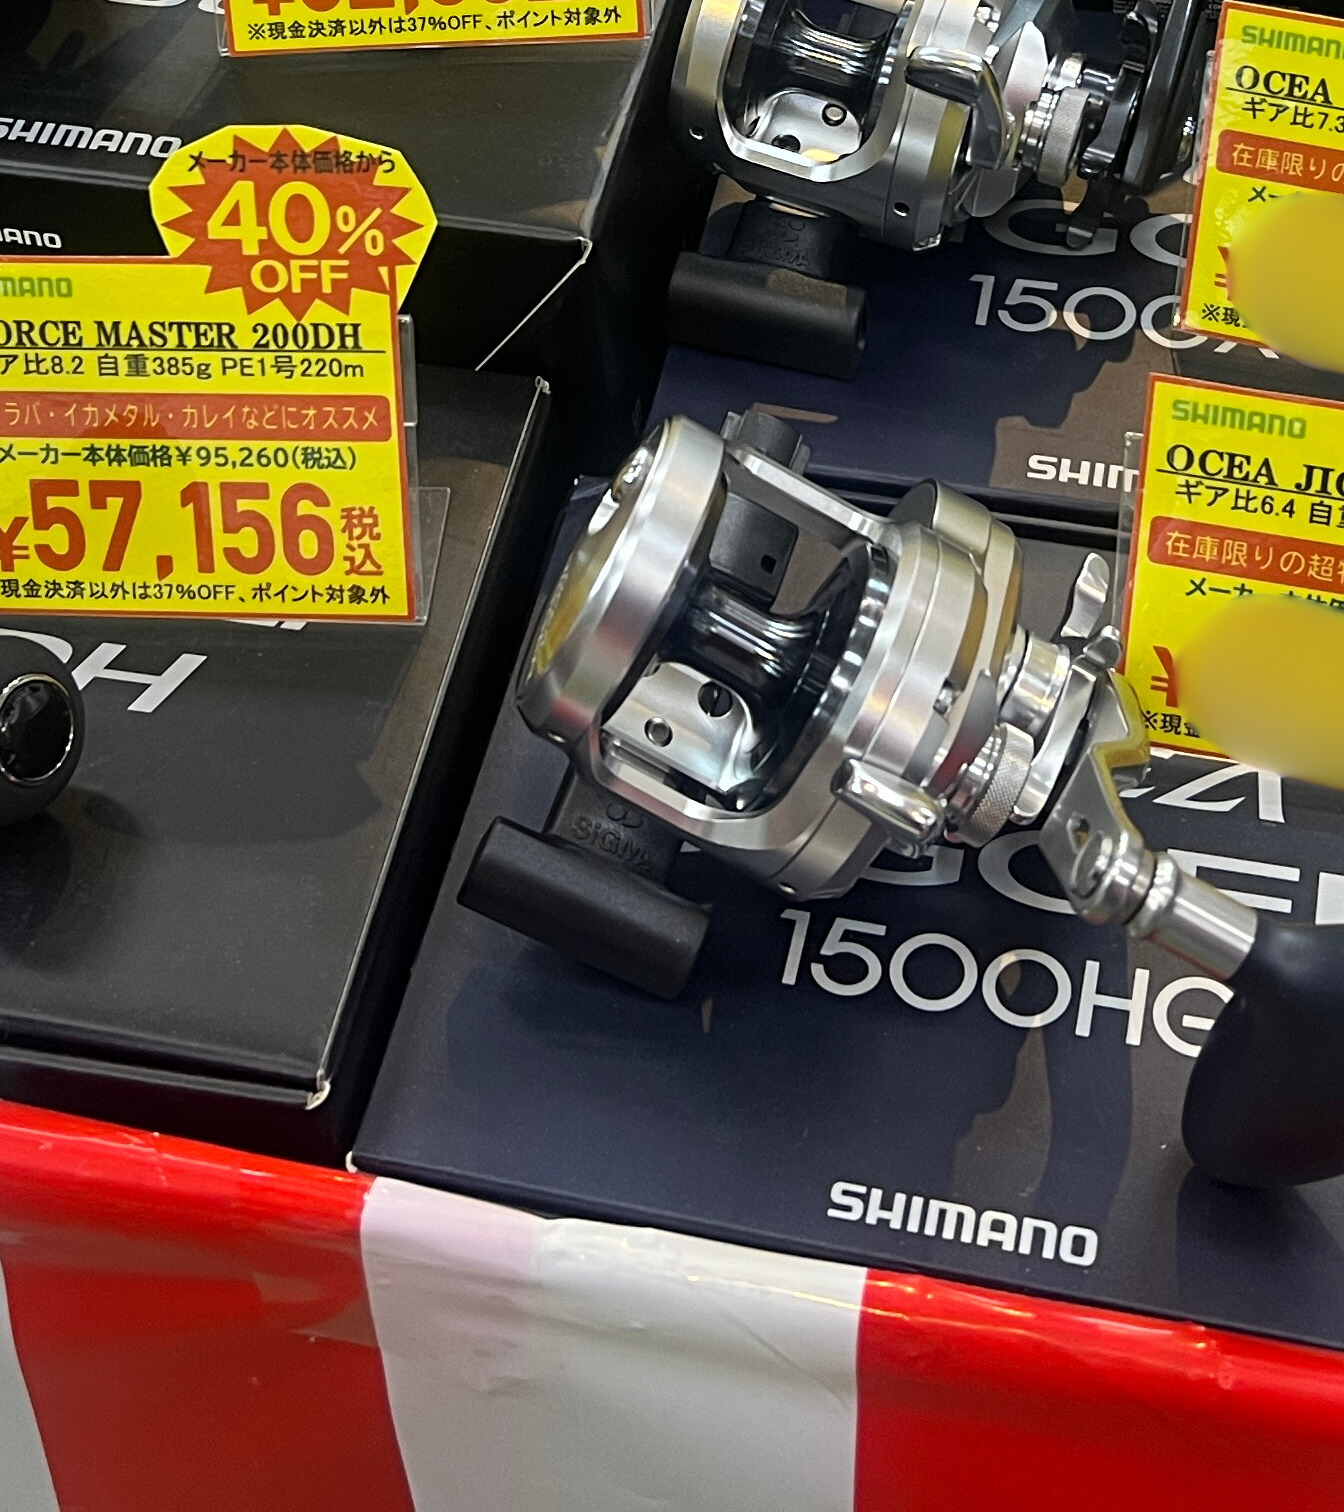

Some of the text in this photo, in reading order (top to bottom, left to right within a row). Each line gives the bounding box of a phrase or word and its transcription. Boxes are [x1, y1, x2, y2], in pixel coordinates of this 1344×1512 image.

[1235, 65, 1332, 105] OCEA
[187, 150, 396, 174] メーカー本体価格から
[207, 179, 384, 256] 40%
[251, 260, 349, 294] OFF
[96, 321, 238, 349] MASTER
[252, 322, 362, 350] 200DH
[98, 355, 212, 379] 自重385g
[221, 357, 364, 378] PE1号220m
[1172, 400, 1306, 439] SHIMANO
[1166, 444, 1276, 487] OCEA
[1174, 480, 1295, 519] ギア比6.4
[341, 507, 384, 576] 税込
[828, 1181, 1097, 1267] SHIMANO
